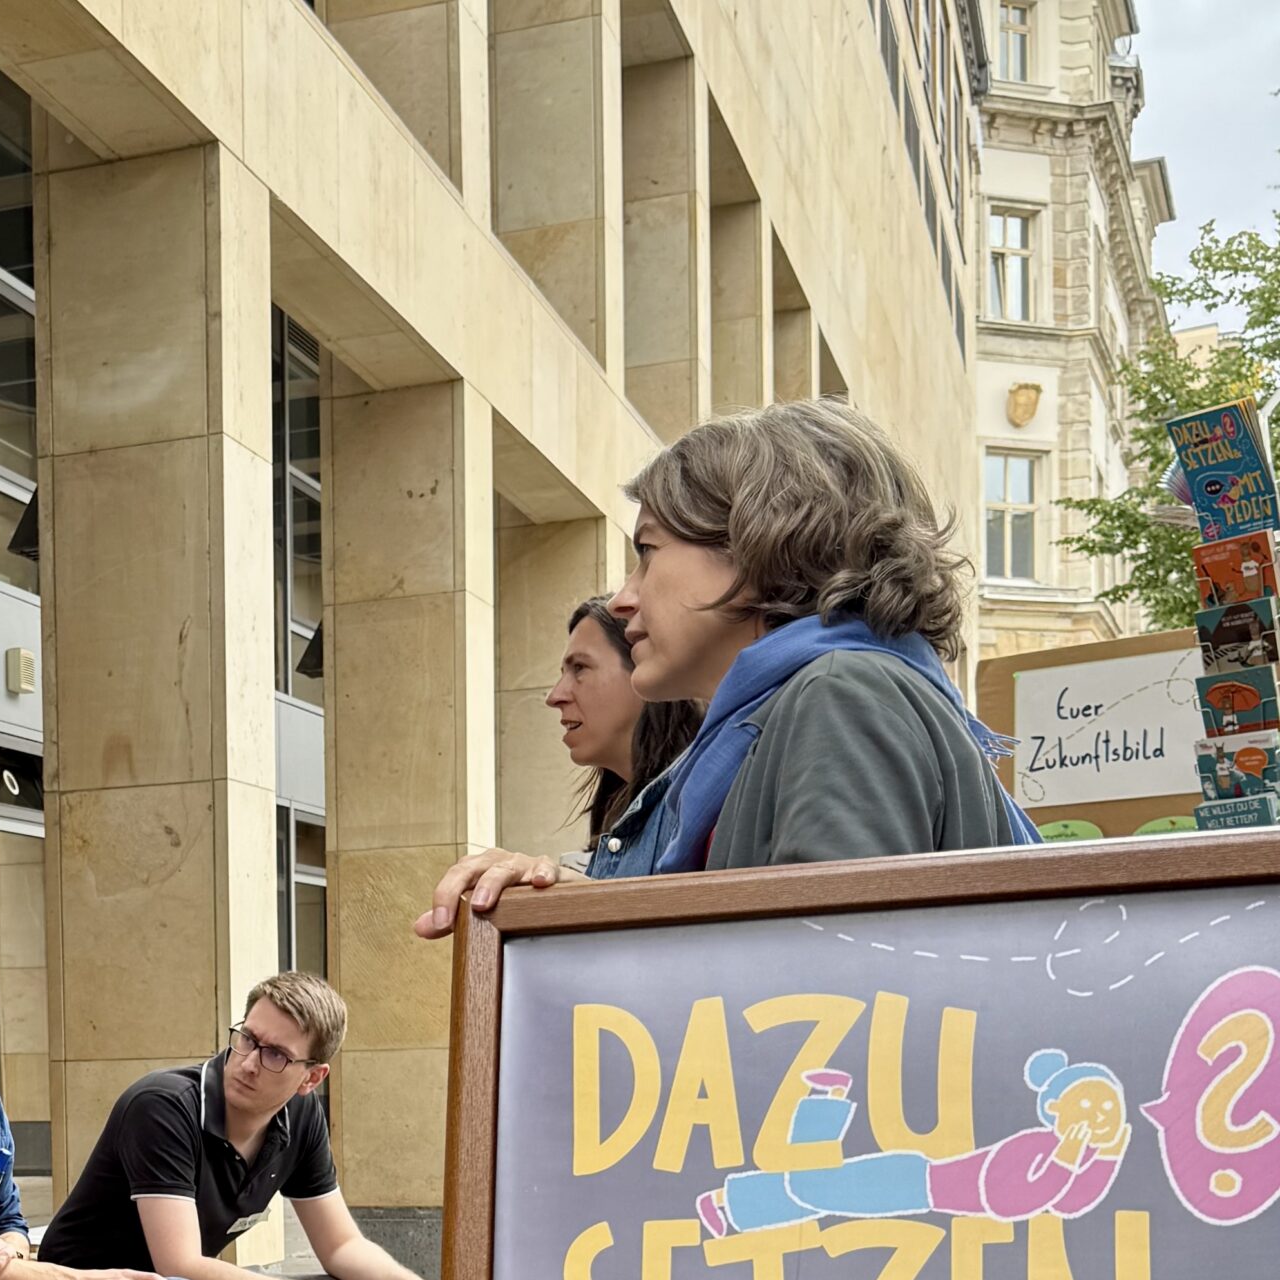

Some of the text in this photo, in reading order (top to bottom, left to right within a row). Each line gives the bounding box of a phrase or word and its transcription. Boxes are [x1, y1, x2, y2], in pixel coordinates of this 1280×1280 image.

[1239, 471, 1265, 495] MIT
[1222, 495, 1272, 526] REDEN
[1057, 687, 1103, 720] Euer
[1029, 727, 1165, 773] Zukunftsbild
[573, 990, 978, 1176] DAZU
